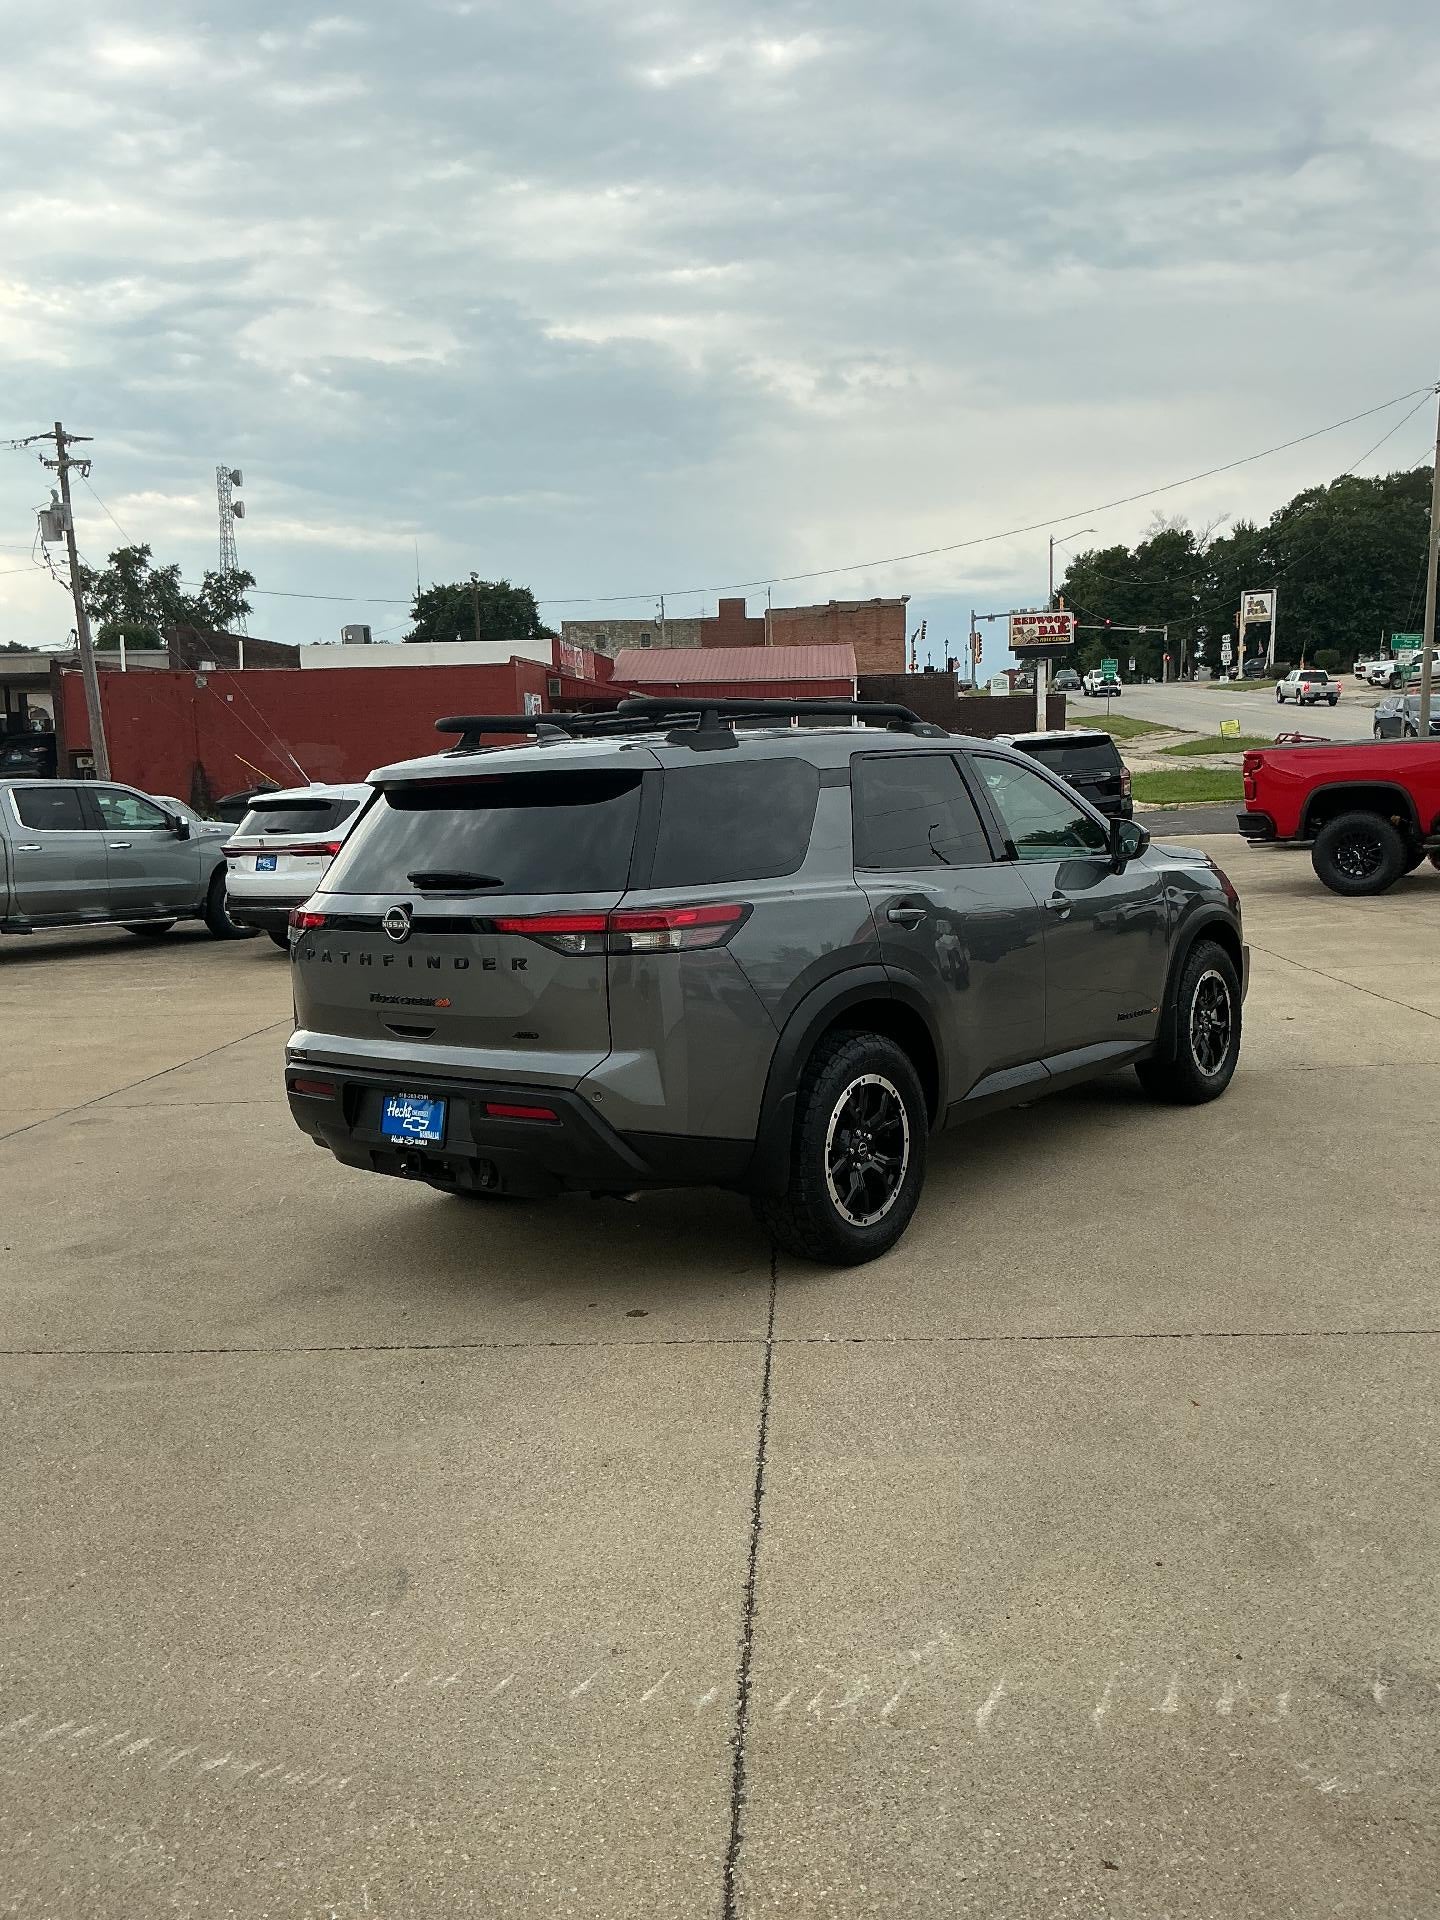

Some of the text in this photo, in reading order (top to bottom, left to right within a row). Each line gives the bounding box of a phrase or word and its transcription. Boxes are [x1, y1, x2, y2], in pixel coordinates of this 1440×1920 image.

[1012, 616, 1071, 625] REDWOOD
[1038, 624, 1067, 635] BAR
[305, 948, 528, 971] PATHFINDER
[387, 1100, 413, 1118] Hecht
